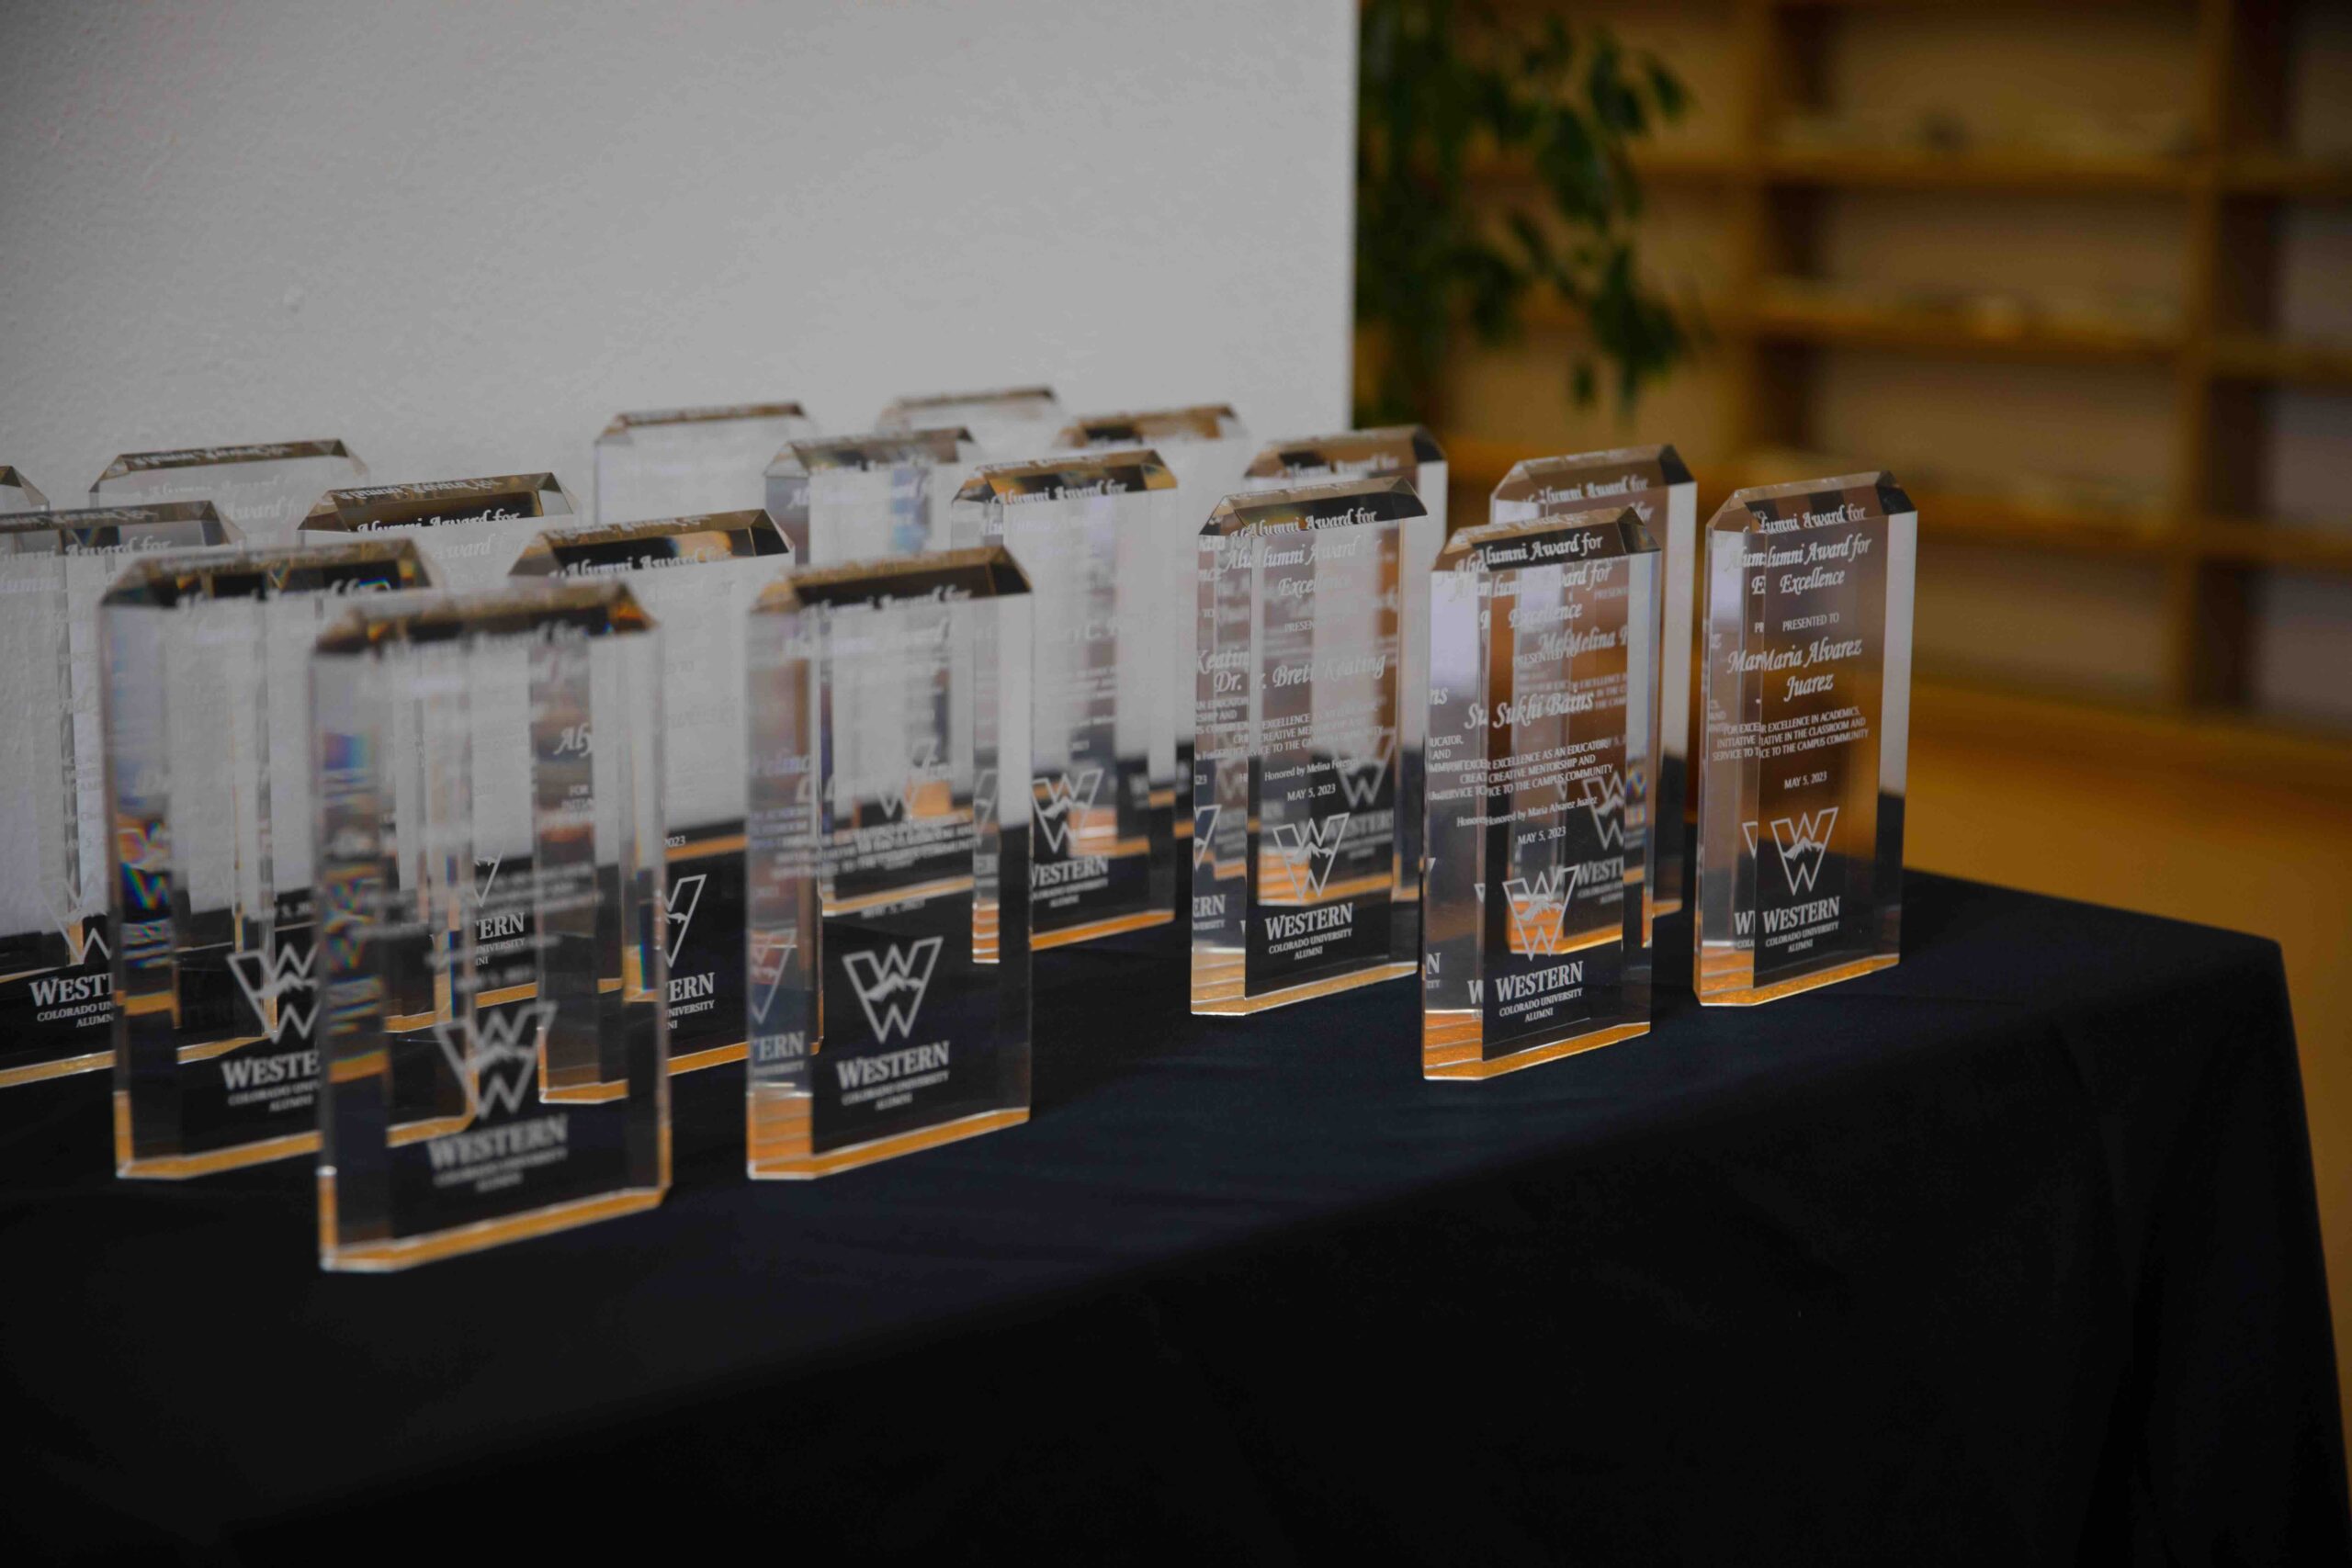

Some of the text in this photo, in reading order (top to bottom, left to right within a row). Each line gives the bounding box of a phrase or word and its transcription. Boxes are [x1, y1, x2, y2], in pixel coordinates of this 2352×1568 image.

[1529, 533, 1579, 561] Award
[1579, 531, 1604, 557] for
[1803, 534, 1854, 566] Award
[1848, 532, 1872, 563] for
[1780, 566, 1847, 595] Excellence
[1782, 612, 1840, 632] PRESENTED TO
[1803, 636, 1863, 669] Alvarez
[1782, 673, 1835, 703] Juarez
[1492, 694, 1544, 728] Sukhi
[1767, 717, 1810, 733] EXCELLENCE
[1810, 713, 1820, 726] IN
[1771, 728, 1869, 758] TO THE CAMPUS COMMUNITY
[1793, 727, 1809, 739] THE
[1808, 720, 1850, 738] CLASSROOM
[1492, 751, 1541, 771] EXCELLENCE
[1577, 754, 1596, 766] AND
[1264, 768, 1296, 783] Honored
[1784, 775, 1802, 789] MAY
[1811, 770, 1828, 784] 2023
[1286, 789, 1306, 802] MAY
[1317, 783, 1337, 796] 2023
[1517, 831, 1536, 845] MAY
[1546, 825, 1566, 839] 2023
[1263, 902, 1353, 942] WESTERN
[1762, 896, 1841, 934] WESTERN
[1268, 928, 1353, 955] COLORADO UNIVERSITY
[1765, 920, 1839, 947] COLORADO UNIVERSITY
[1788, 939, 1814, 953] ALUMNI
[1294, 946, 1323, 961] ALUMNI
[1494, 961, 1584, 1003] WESTERN
[36, 1003, 97, 1023] COLORADO
[665, 998, 715, 1019] NIVERSITY
[1498, 987, 1583, 1019] COLORADO UNIVERSITY
[1524, 1008, 1554, 1023] ALUMNI
[220, 1050, 321, 1091] WESTE
[836, 1041, 952, 1091] WESTERN
